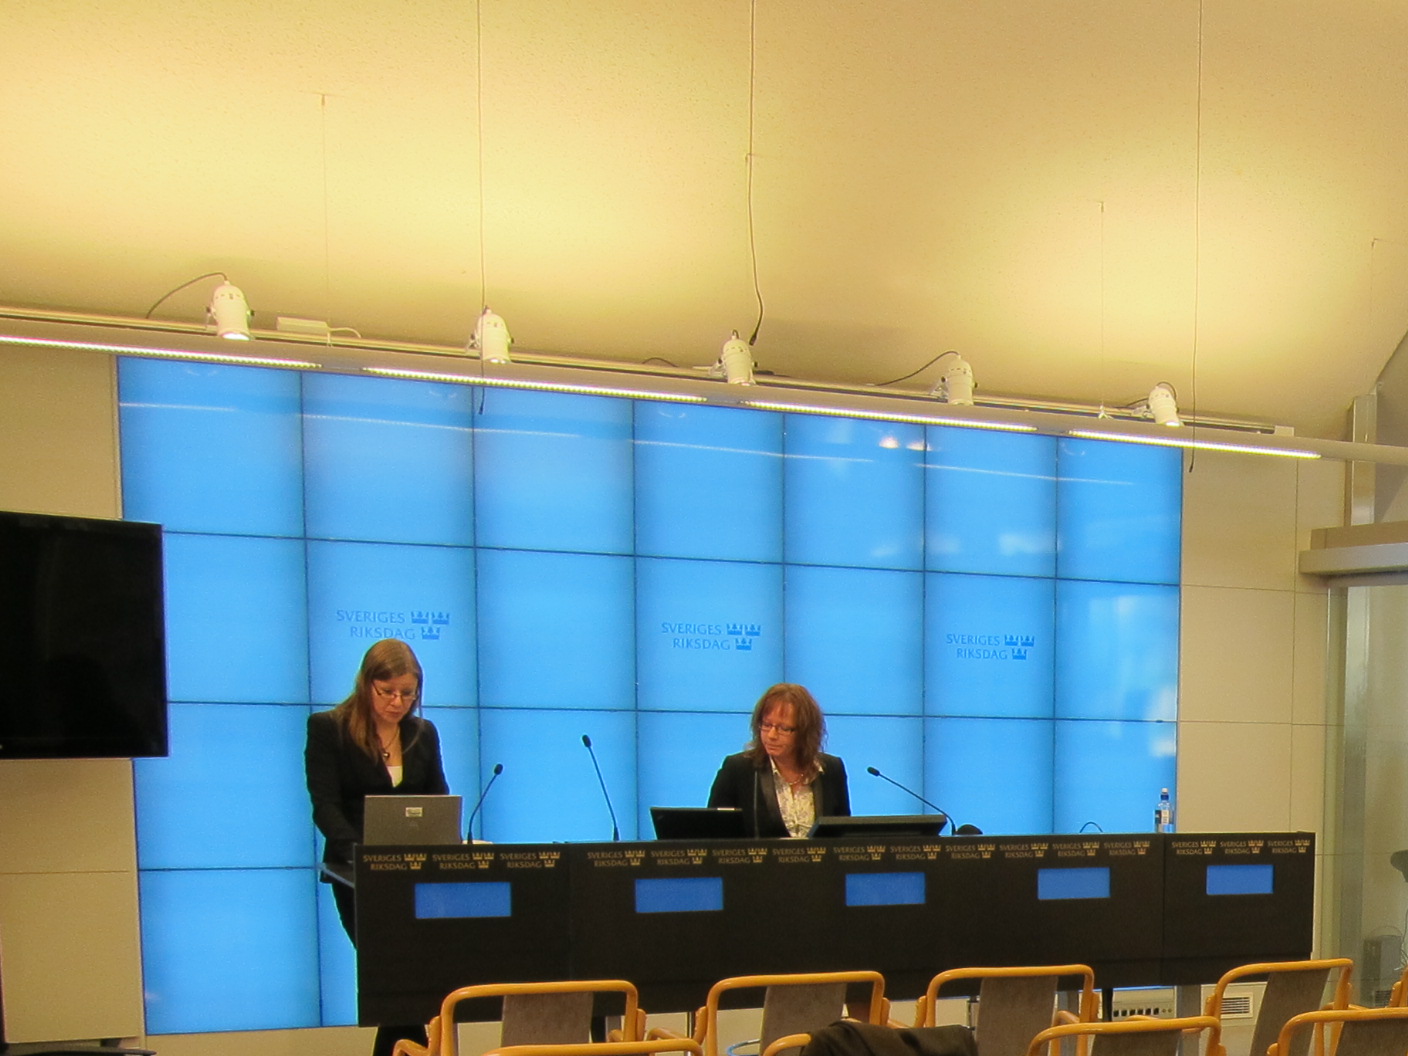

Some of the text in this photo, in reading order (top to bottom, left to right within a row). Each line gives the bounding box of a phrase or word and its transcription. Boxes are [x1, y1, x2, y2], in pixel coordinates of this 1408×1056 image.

[336, 609, 406, 624] SVERIGES
[350, 626, 415, 640] RIKSDAG
[661, 622, 722, 635] SVERIGES
[672, 638, 730, 650] RIKSDAG
[946, 634, 1000, 646] SVERIGES
[956, 647, 1008, 660] RIKSDAG
